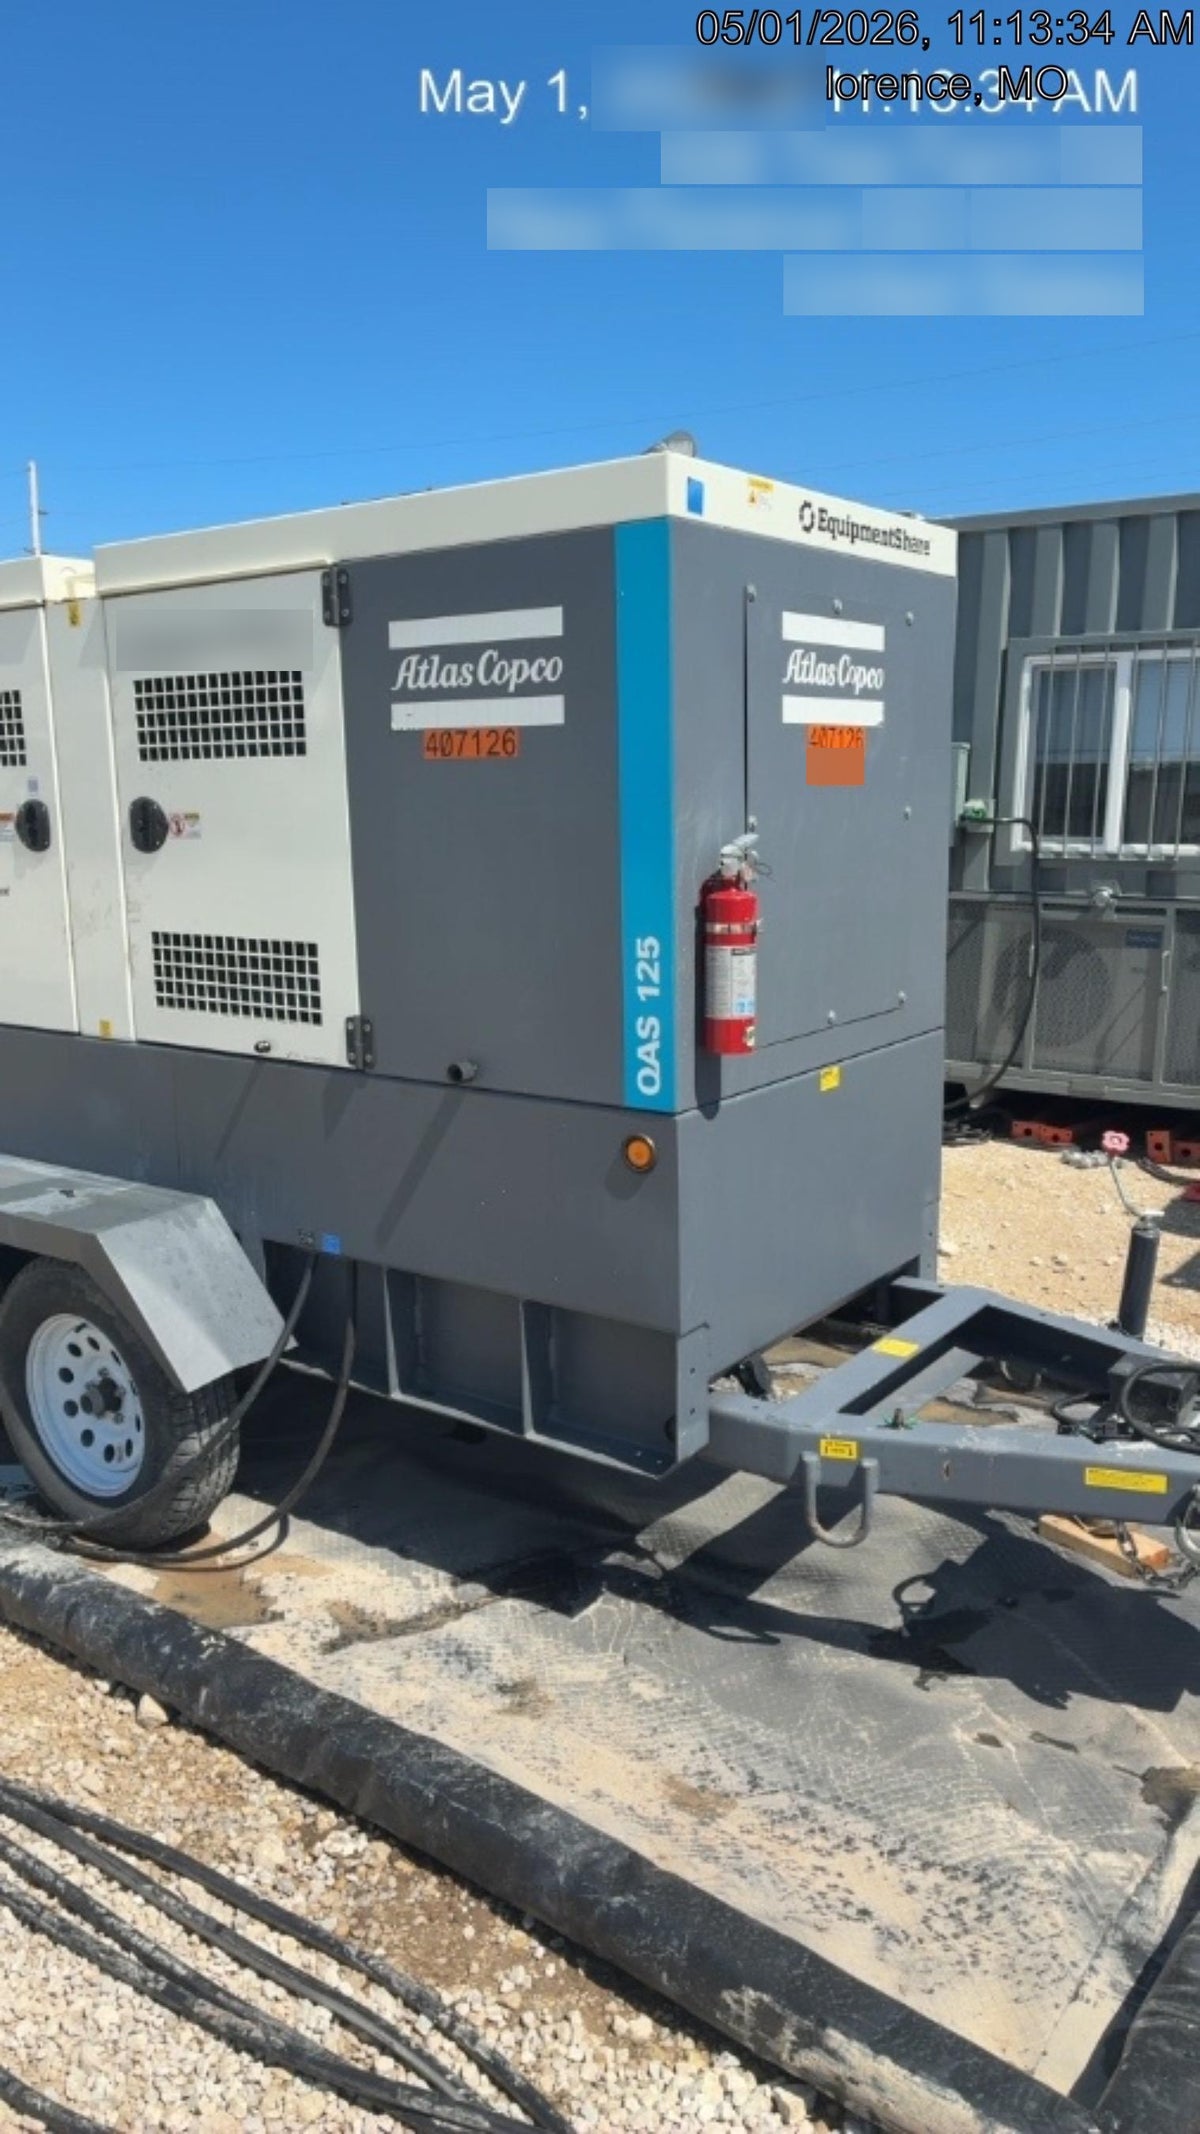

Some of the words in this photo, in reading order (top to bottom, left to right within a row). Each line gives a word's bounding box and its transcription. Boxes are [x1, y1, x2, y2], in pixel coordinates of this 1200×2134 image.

[817, 507, 931, 556] EquipmentShare
[425, 727, 518, 758] 407126
[635, 935, 661, 1002] 125
